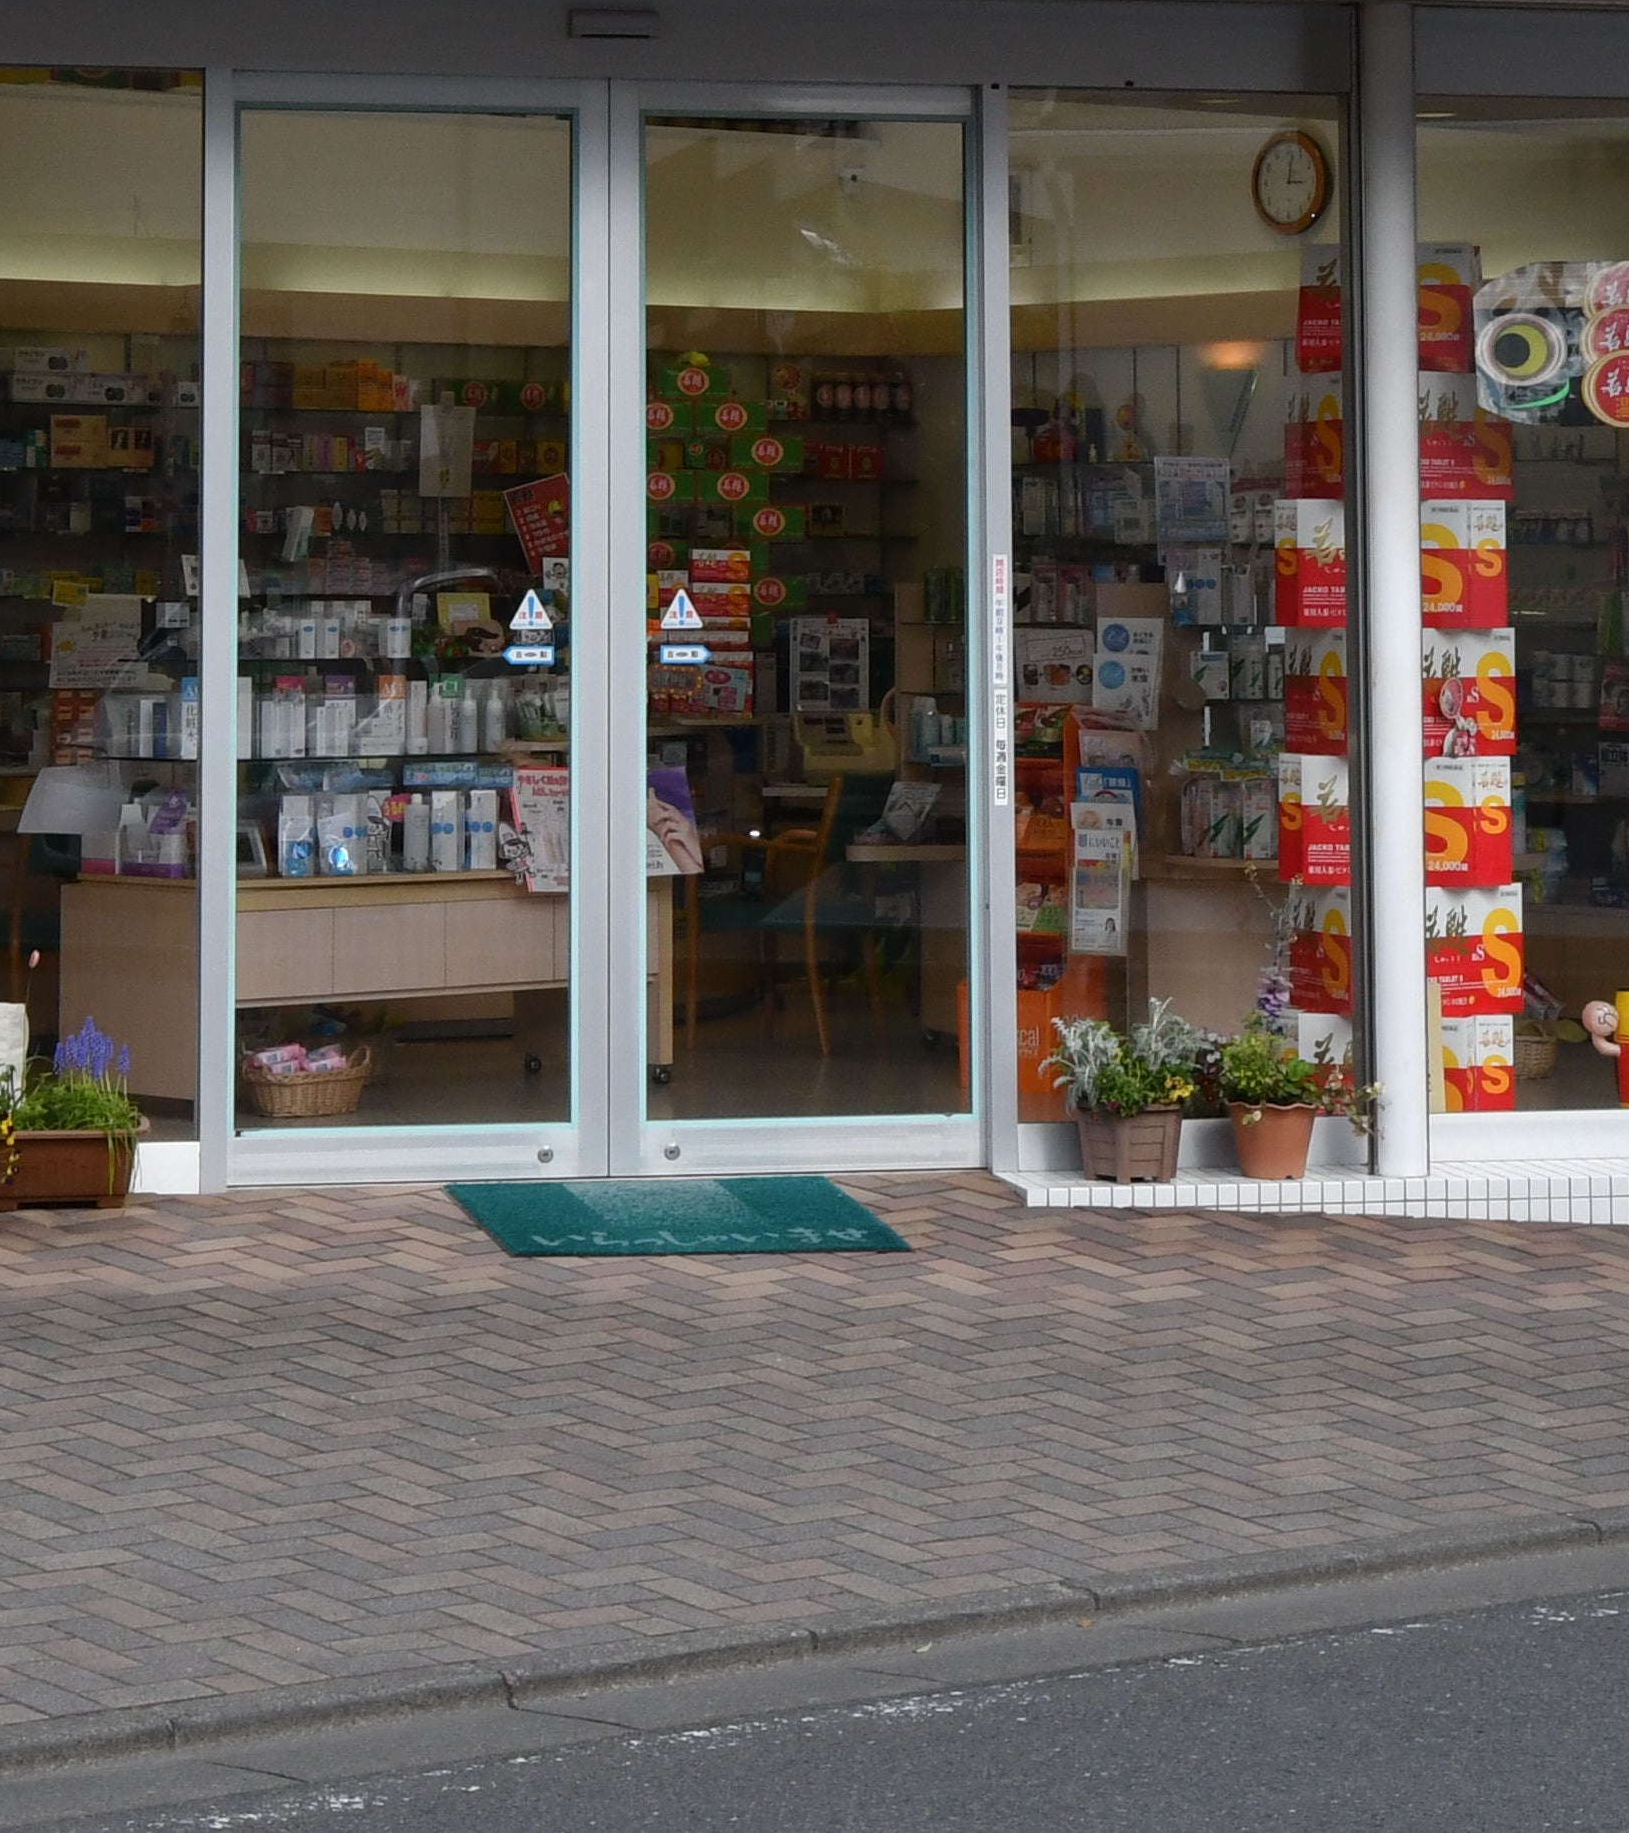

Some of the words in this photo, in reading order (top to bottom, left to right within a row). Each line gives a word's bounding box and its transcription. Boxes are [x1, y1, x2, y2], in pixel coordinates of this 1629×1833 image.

[1475, 538, 1502, 577] S
[995, 693, 1006, 729] 定休日
[1475, 651, 1514, 742] S
[995, 739, 1007, 800] 毎週金曜日
[1480, 794, 1508, 835] S
[1308, 844, 1333, 852] JACKO
[1481, 908, 1522, 999] S
[1481, 1054, 1510, 1096] S
